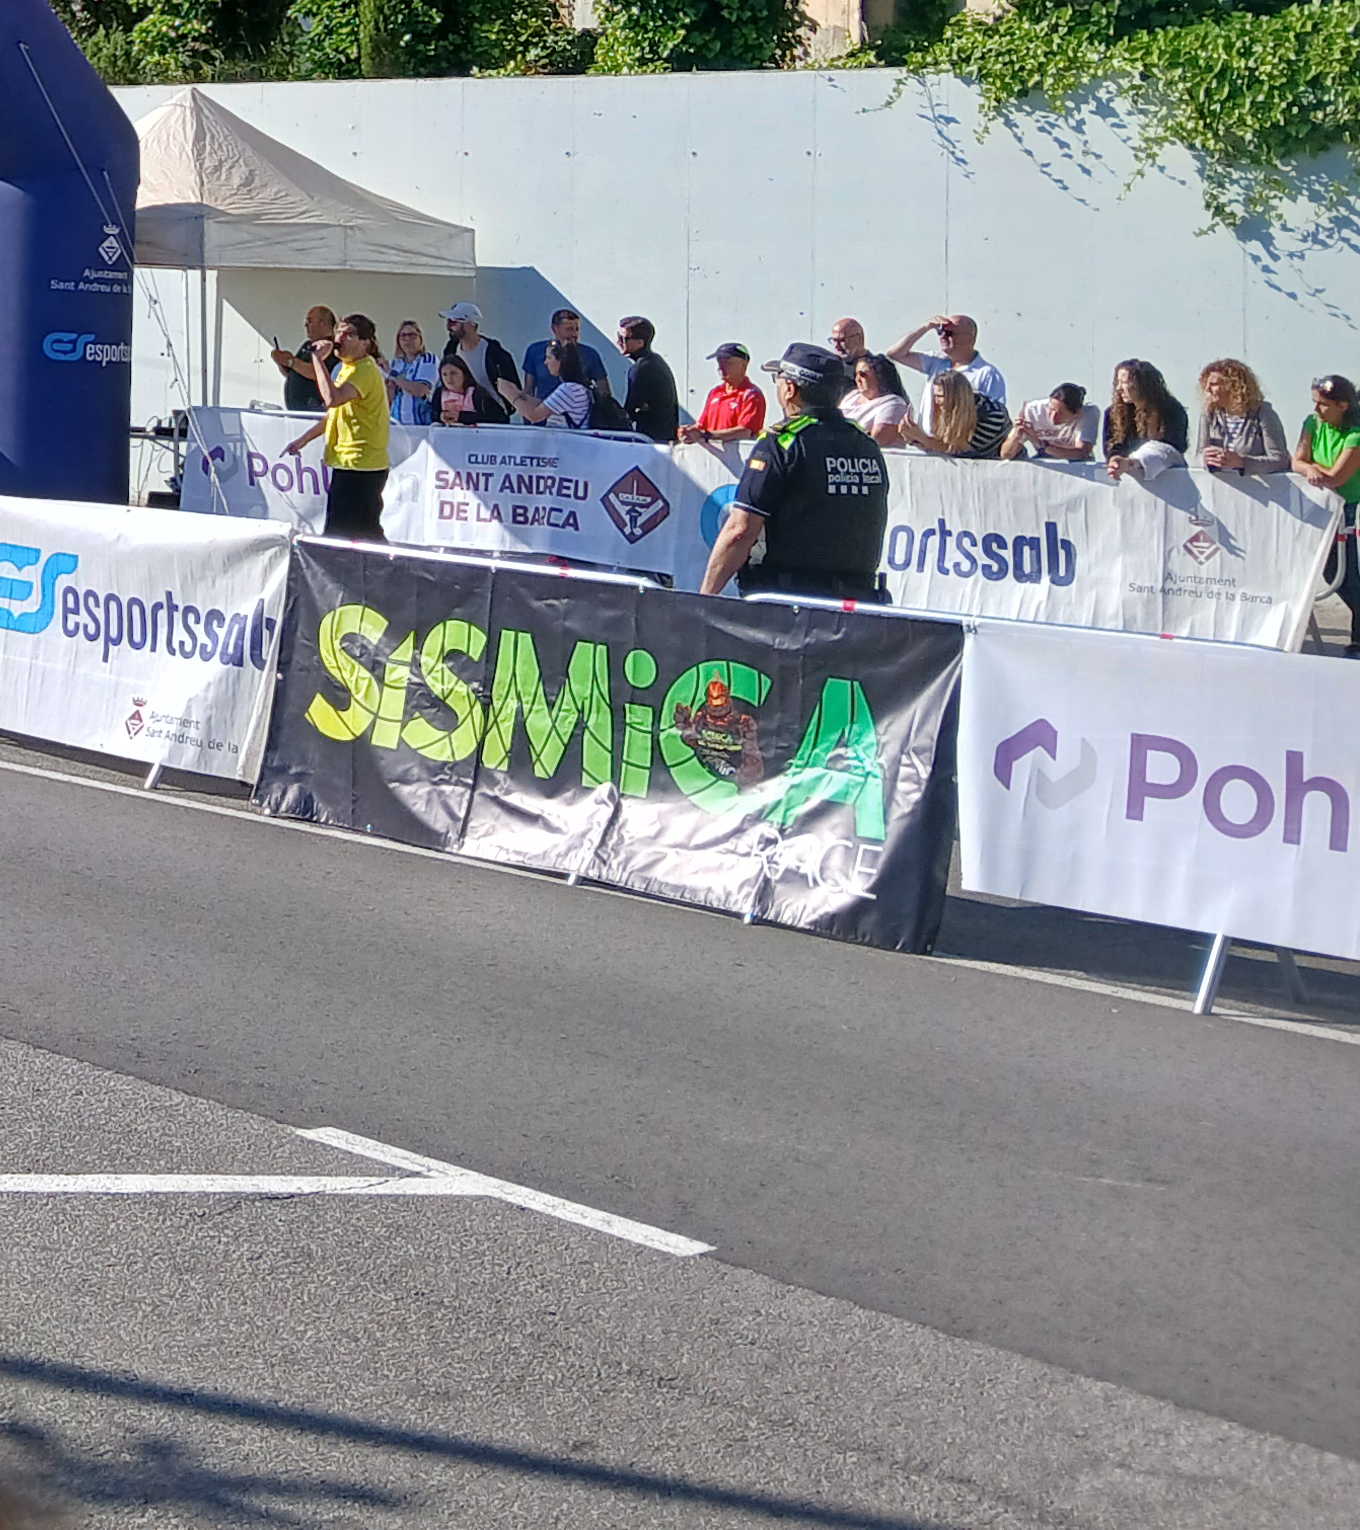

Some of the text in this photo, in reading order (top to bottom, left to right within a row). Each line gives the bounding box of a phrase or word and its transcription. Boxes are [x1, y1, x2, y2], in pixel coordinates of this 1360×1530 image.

[468, 453, 497, 466] CLUB
[435, 469, 589, 501] SANT ANDREU
[438, 500, 469, 521] DE
[476, 503, 503, 523] LA
[887, 517, 1077, 587] ortssab
[1164, 571, 1237, 588] Ajuntament
[1128, 582, 1273, 605] Sant Andreu de la Barca
[164, 729, 204, 750] Andreu
[207, 738, 224, 752] de
[228, 741, 239, 754] la
[1126, 732, 1350, 854] Poh
